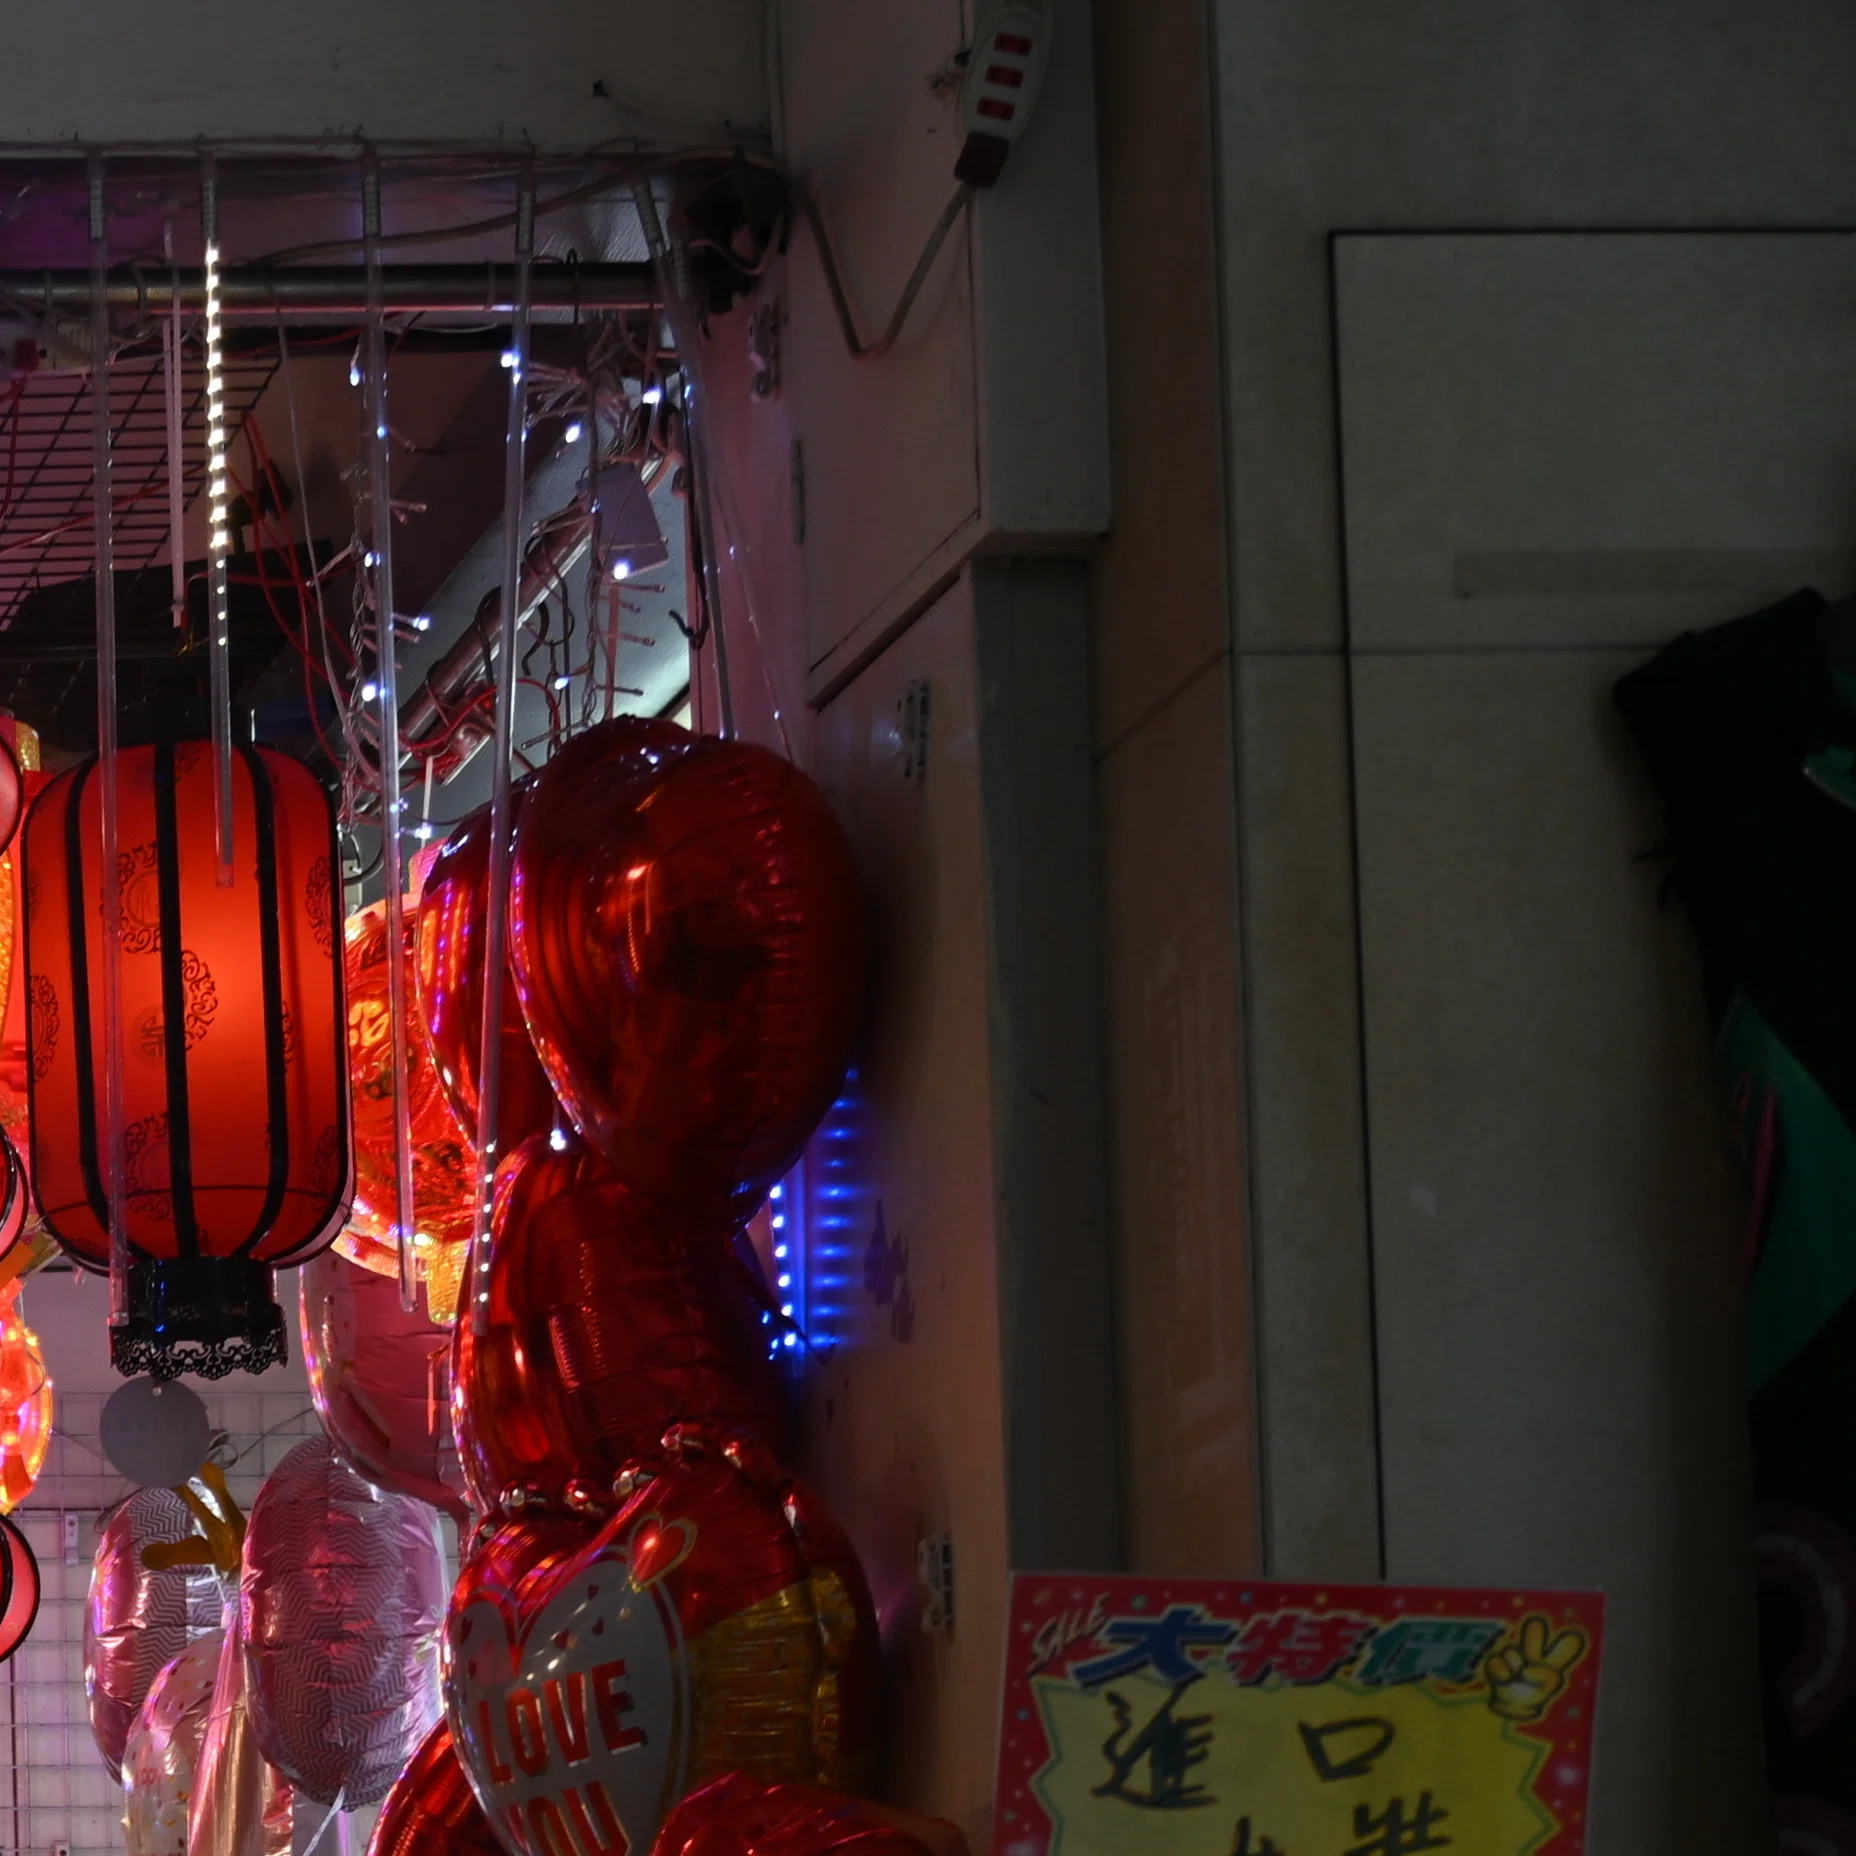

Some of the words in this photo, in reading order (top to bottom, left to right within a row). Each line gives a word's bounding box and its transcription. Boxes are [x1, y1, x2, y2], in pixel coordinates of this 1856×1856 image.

[1069, 1607, 1506, 1689] 大特價
[479, 1659, 648, 1787] LOVE
[1091, 1688, 1396, 1810] 進口
